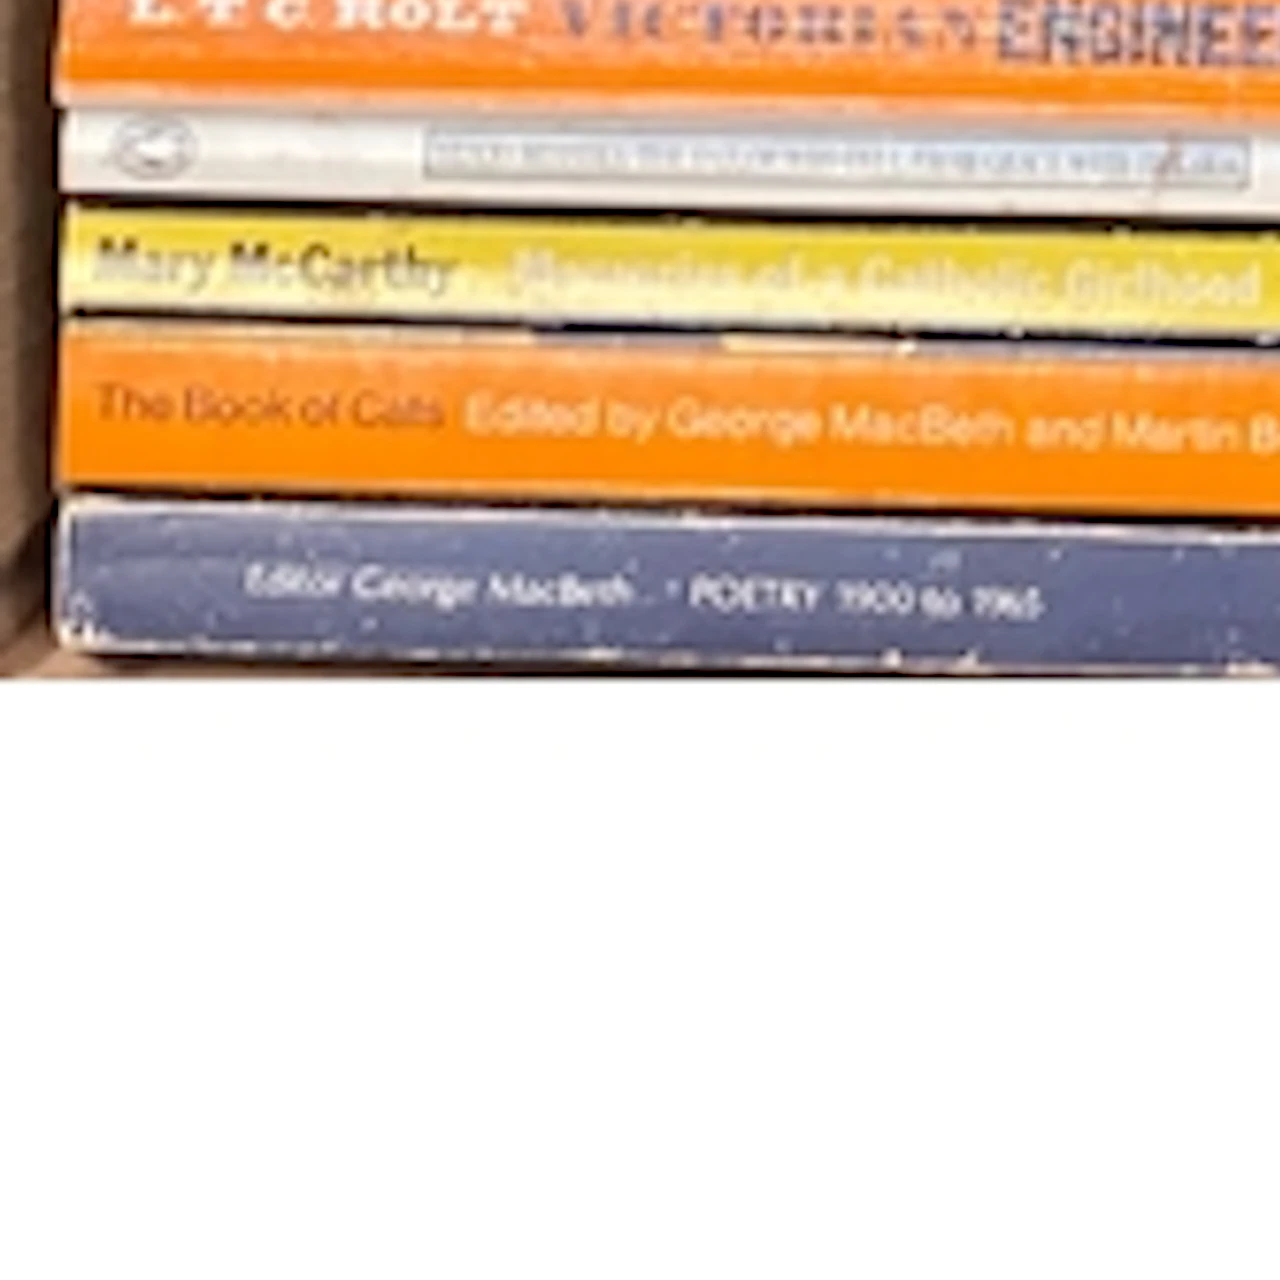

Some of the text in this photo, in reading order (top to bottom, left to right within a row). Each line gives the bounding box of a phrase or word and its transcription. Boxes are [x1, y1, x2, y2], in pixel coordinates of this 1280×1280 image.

[97, 233, 462, 298] Mary McCarthy
[99, 382, 176, 423] The
[185, 385, 289, 426] Book
[299, 386, 344, 428] of
[352, 388, 448, 430] Cats
[465, 390, 601, 434] Edited
[604, 394, 660, 444] by
[666, 394, 823, 448] George
[1026, 412, 1104, 450] and
[1111, 412, 1241, 456] Martin
[245, 560, 636, 612] Editor George MacBeth
[688, 572, 826, 614] POETRY
[834, 578, 916, 618] 1900
